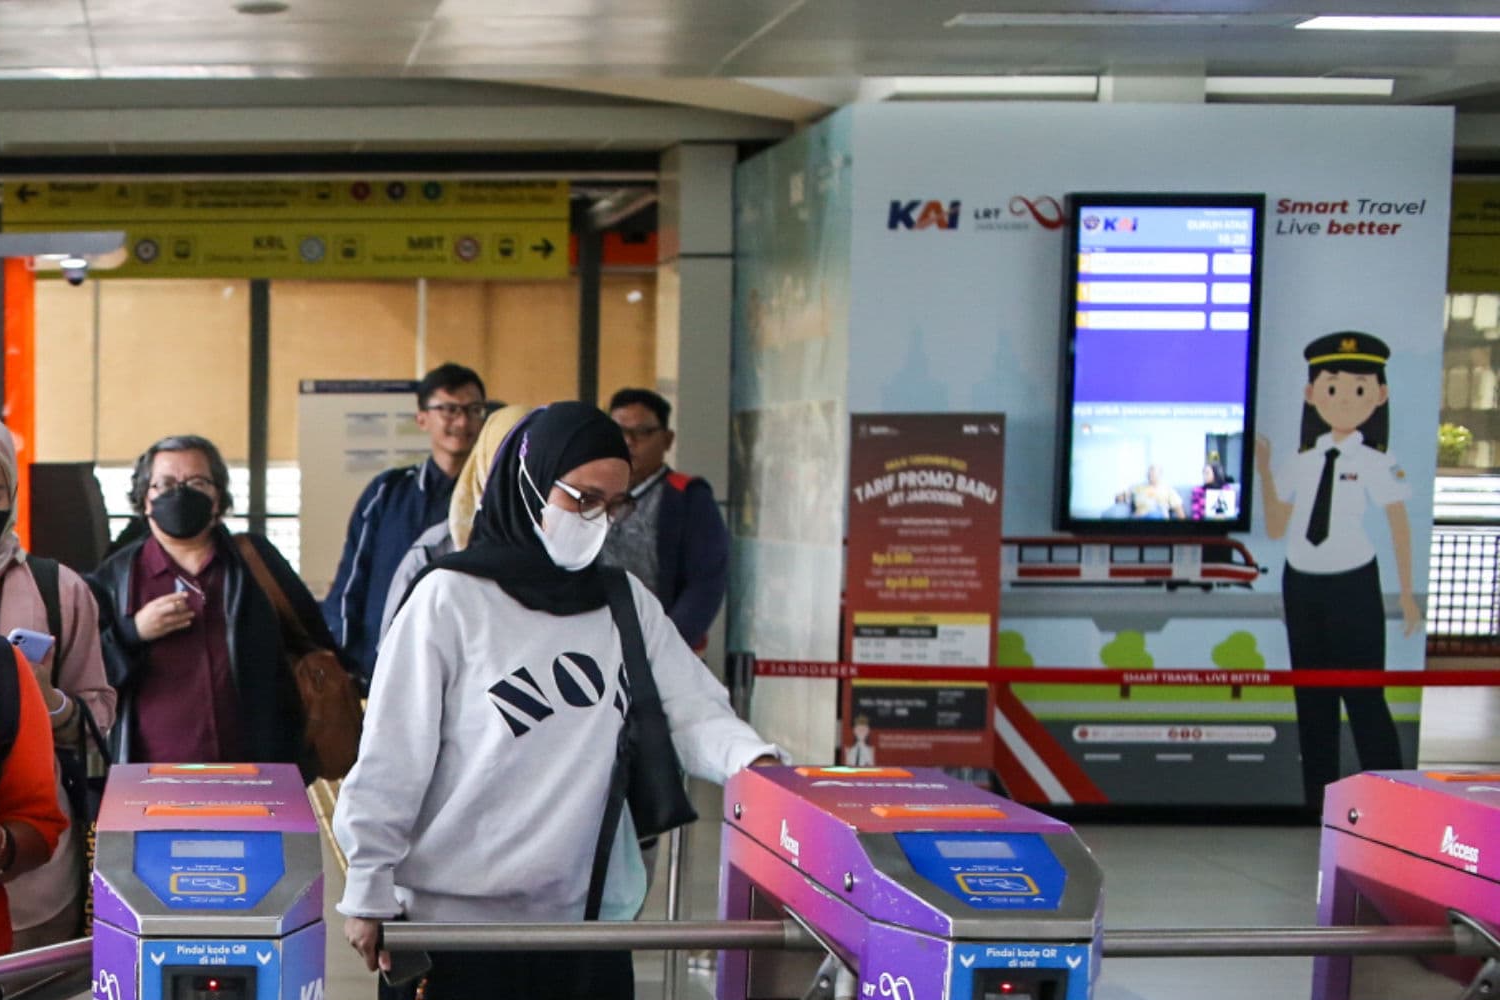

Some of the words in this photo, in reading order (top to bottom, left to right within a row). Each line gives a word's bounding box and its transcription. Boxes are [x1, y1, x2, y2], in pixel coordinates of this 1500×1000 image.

[974, 207, 1001, 220] LRT
[1276, 198, 1349, 215] Smart
[1356, 199, 1426, 216] Travel
[1276, 218, 1321, 235] Live
[1327, 218, 1402, 235] better
[854, 474, 896, 503] TARIF
[898, 470, 954, 489] PROMO
[955, 473, 998, 505] BARU
[1122, 672, 1159, 683] SMART
[1205, 673, 1228, 683] LIVE
[1230, 673, 1270, 683] BETTER
[177, 944, 207, 955] Pindai
[208, 944, 230, 955] kode
[231, 944, 246, 956] QR
[986, 947, 1015, 959] Pindai
[1017, 947, 1039, 958] kode
[1041, 947, 1058, 959] QR
